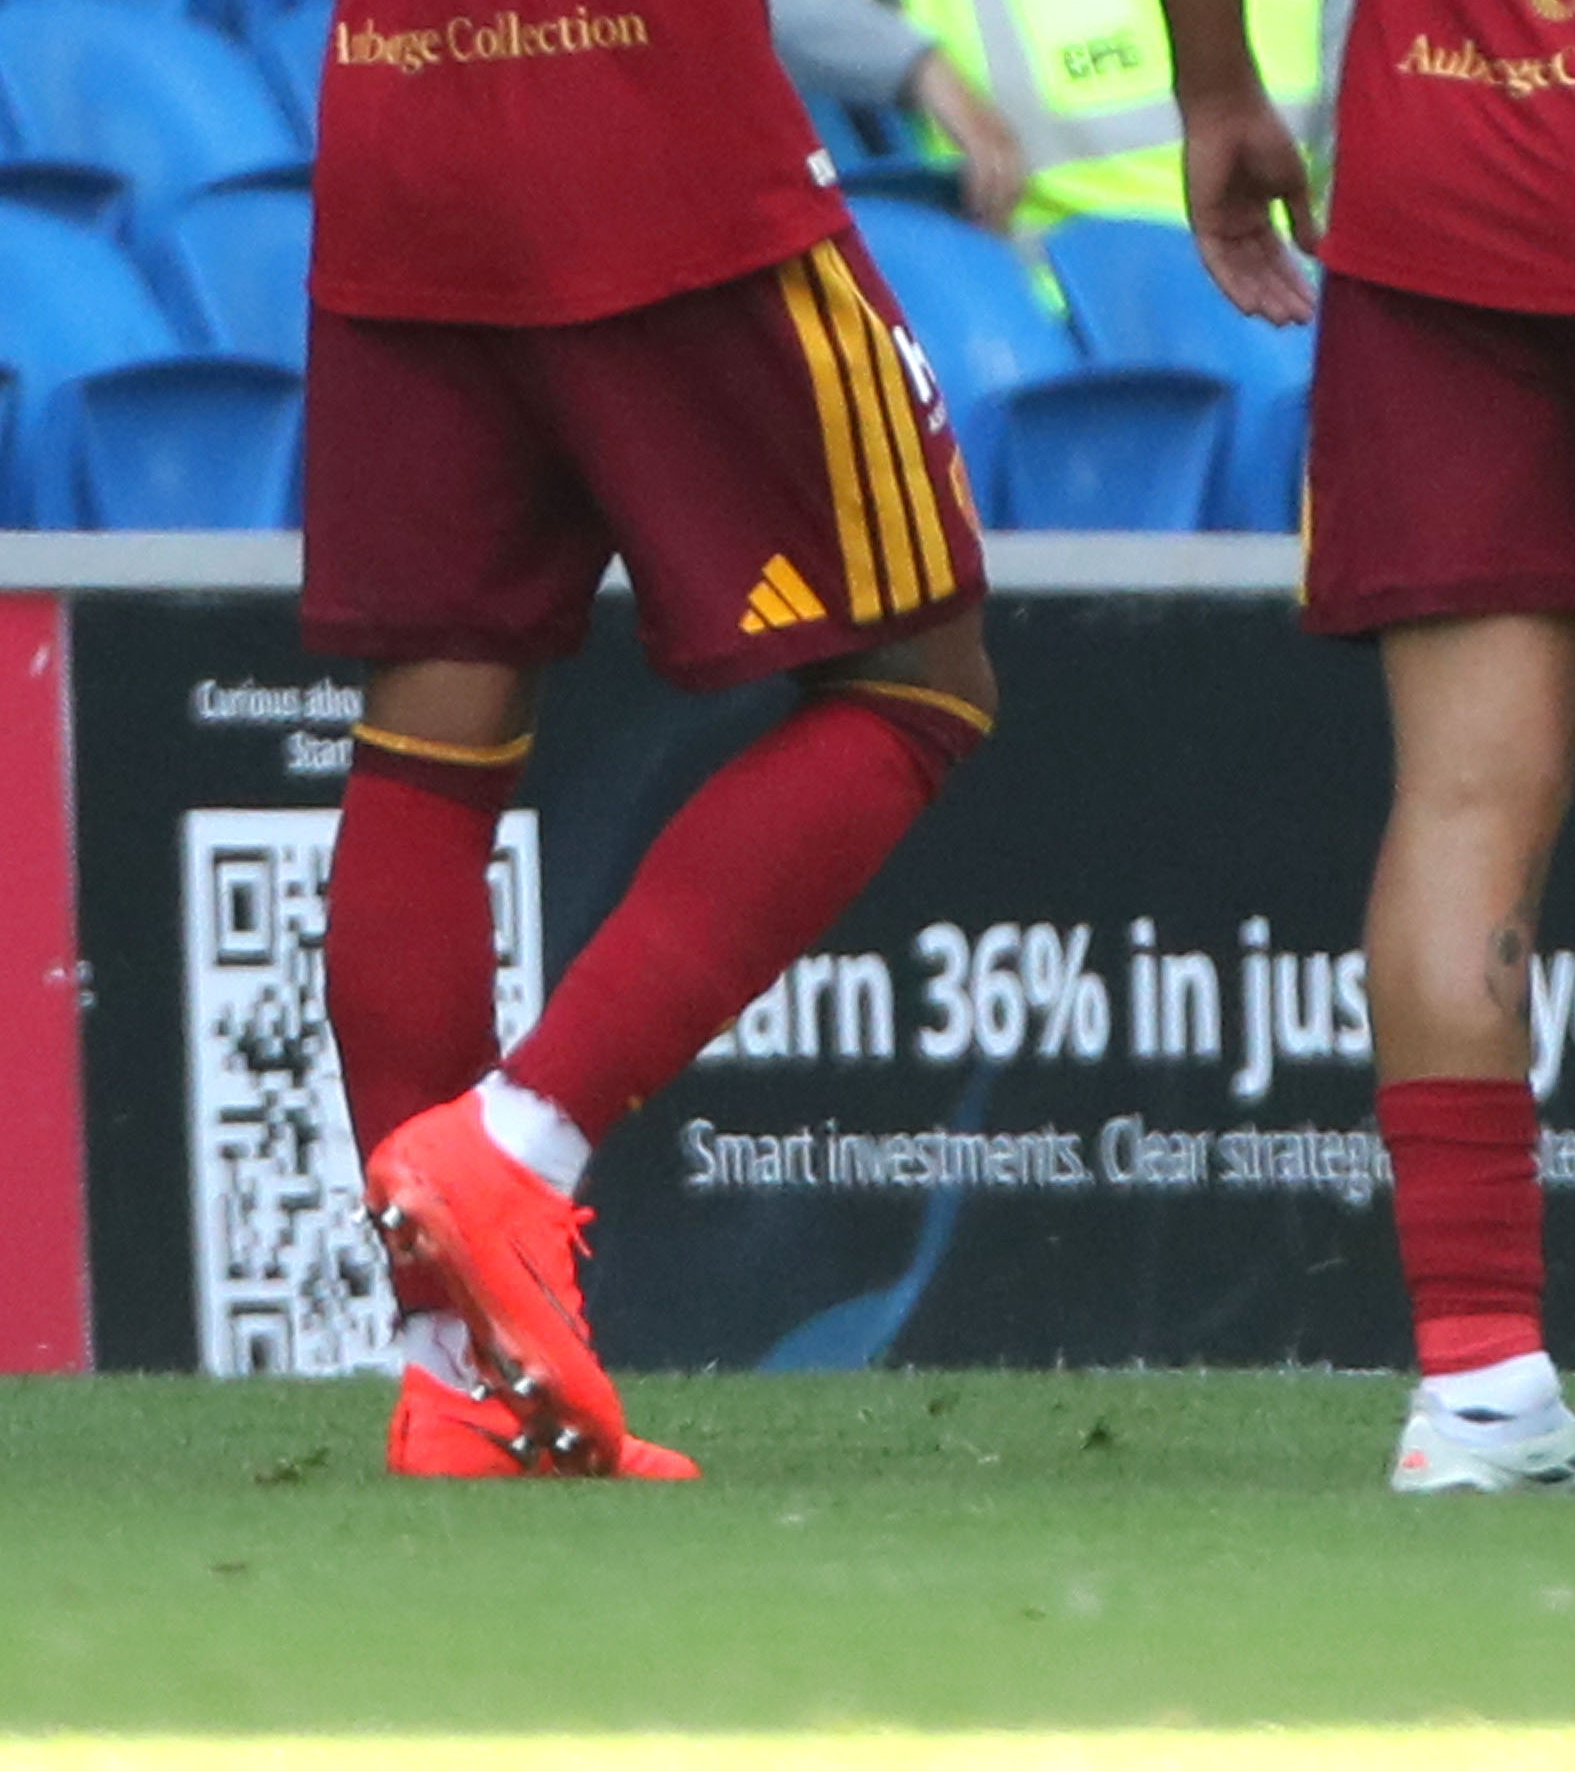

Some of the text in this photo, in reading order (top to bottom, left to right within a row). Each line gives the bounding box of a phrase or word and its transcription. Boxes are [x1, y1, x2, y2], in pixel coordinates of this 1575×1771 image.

[448, 5, 649, 63] Collection
[917, 921, 1111, 1062] 36%
[1130, 916, 1220, 1058] in
[1231, 915, 1373, 1098] jus
[684, 1118, 819, 1186] Smart
